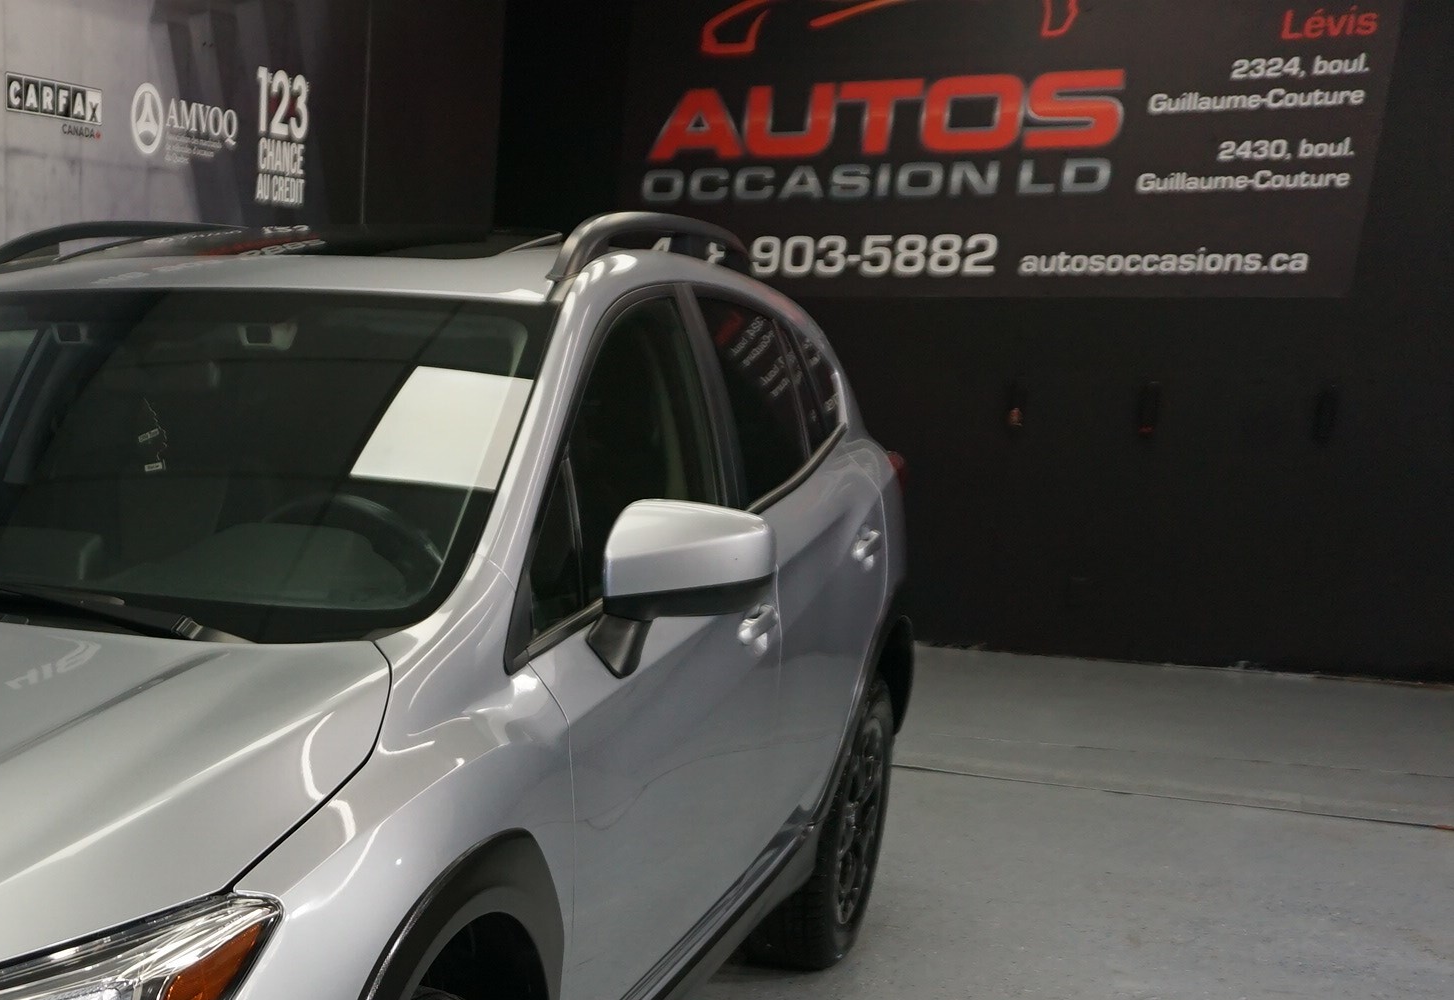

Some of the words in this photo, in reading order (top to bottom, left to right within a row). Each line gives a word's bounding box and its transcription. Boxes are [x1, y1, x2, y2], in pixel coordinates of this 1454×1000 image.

[1281, 6, 1379, 40] Lévis
[1230, 56, 1306, 81] 2324,
[1312, 52, 1370, 77] boul.
[8, 79, 101, 123] CARFAX
[648, 69, 1126, 160] AUTOS
[1148, 87, 1366, 115] Guillaume-Couture
[61, 123, 95, 139] CANADA
[165, 97, 238, 146] AMVOQ
[258, 136, 305, 175] CHANCE
[1217, 138, 1293, 162] 2430,
[1298, 136, 1356, 159] boul.
[255, 172, 271, 201] AU
[642, 159, 1000, 201] OCCASION
[1018, 156, 1112, 195] LD
[1136, 169, 1351, 195] Guillaume-Couture
[751, 233, 998, 279] 903-5882
[1019, 246, 1310, 276] autosoccasions.ca
